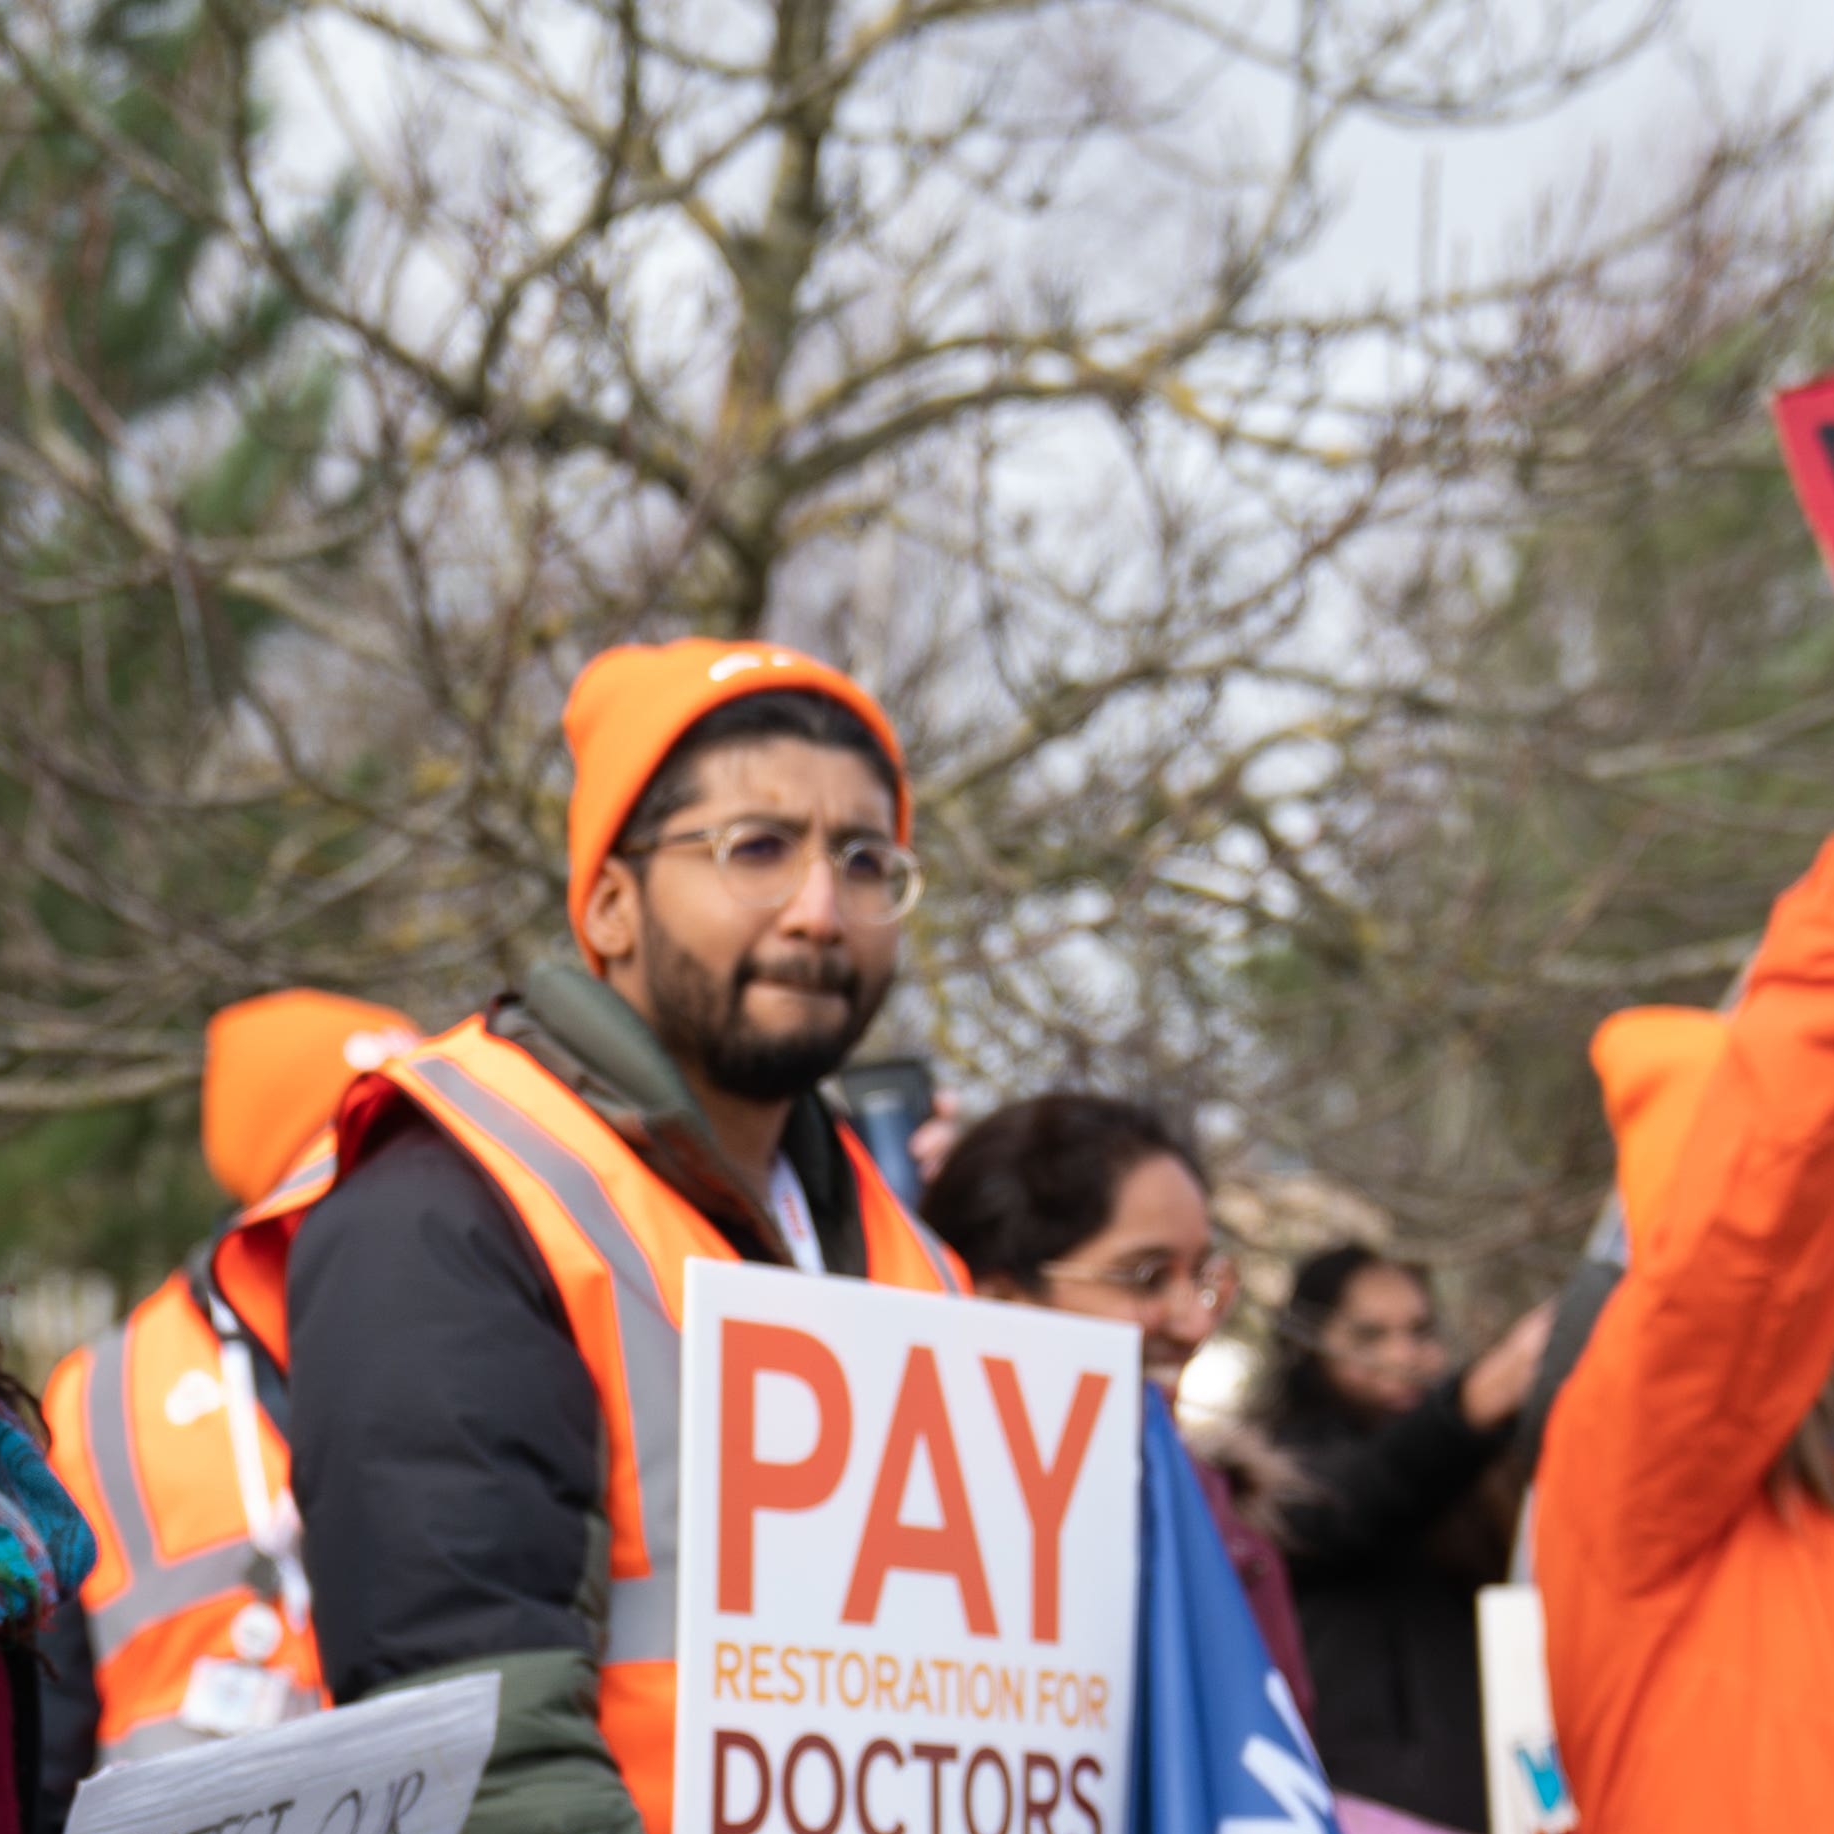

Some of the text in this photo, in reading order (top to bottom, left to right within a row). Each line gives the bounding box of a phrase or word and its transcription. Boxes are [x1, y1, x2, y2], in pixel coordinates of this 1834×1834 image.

[715, 1317, 1112, 1645] PAY
[713, 1641, 1110, 1729] RESTORATION FOR
